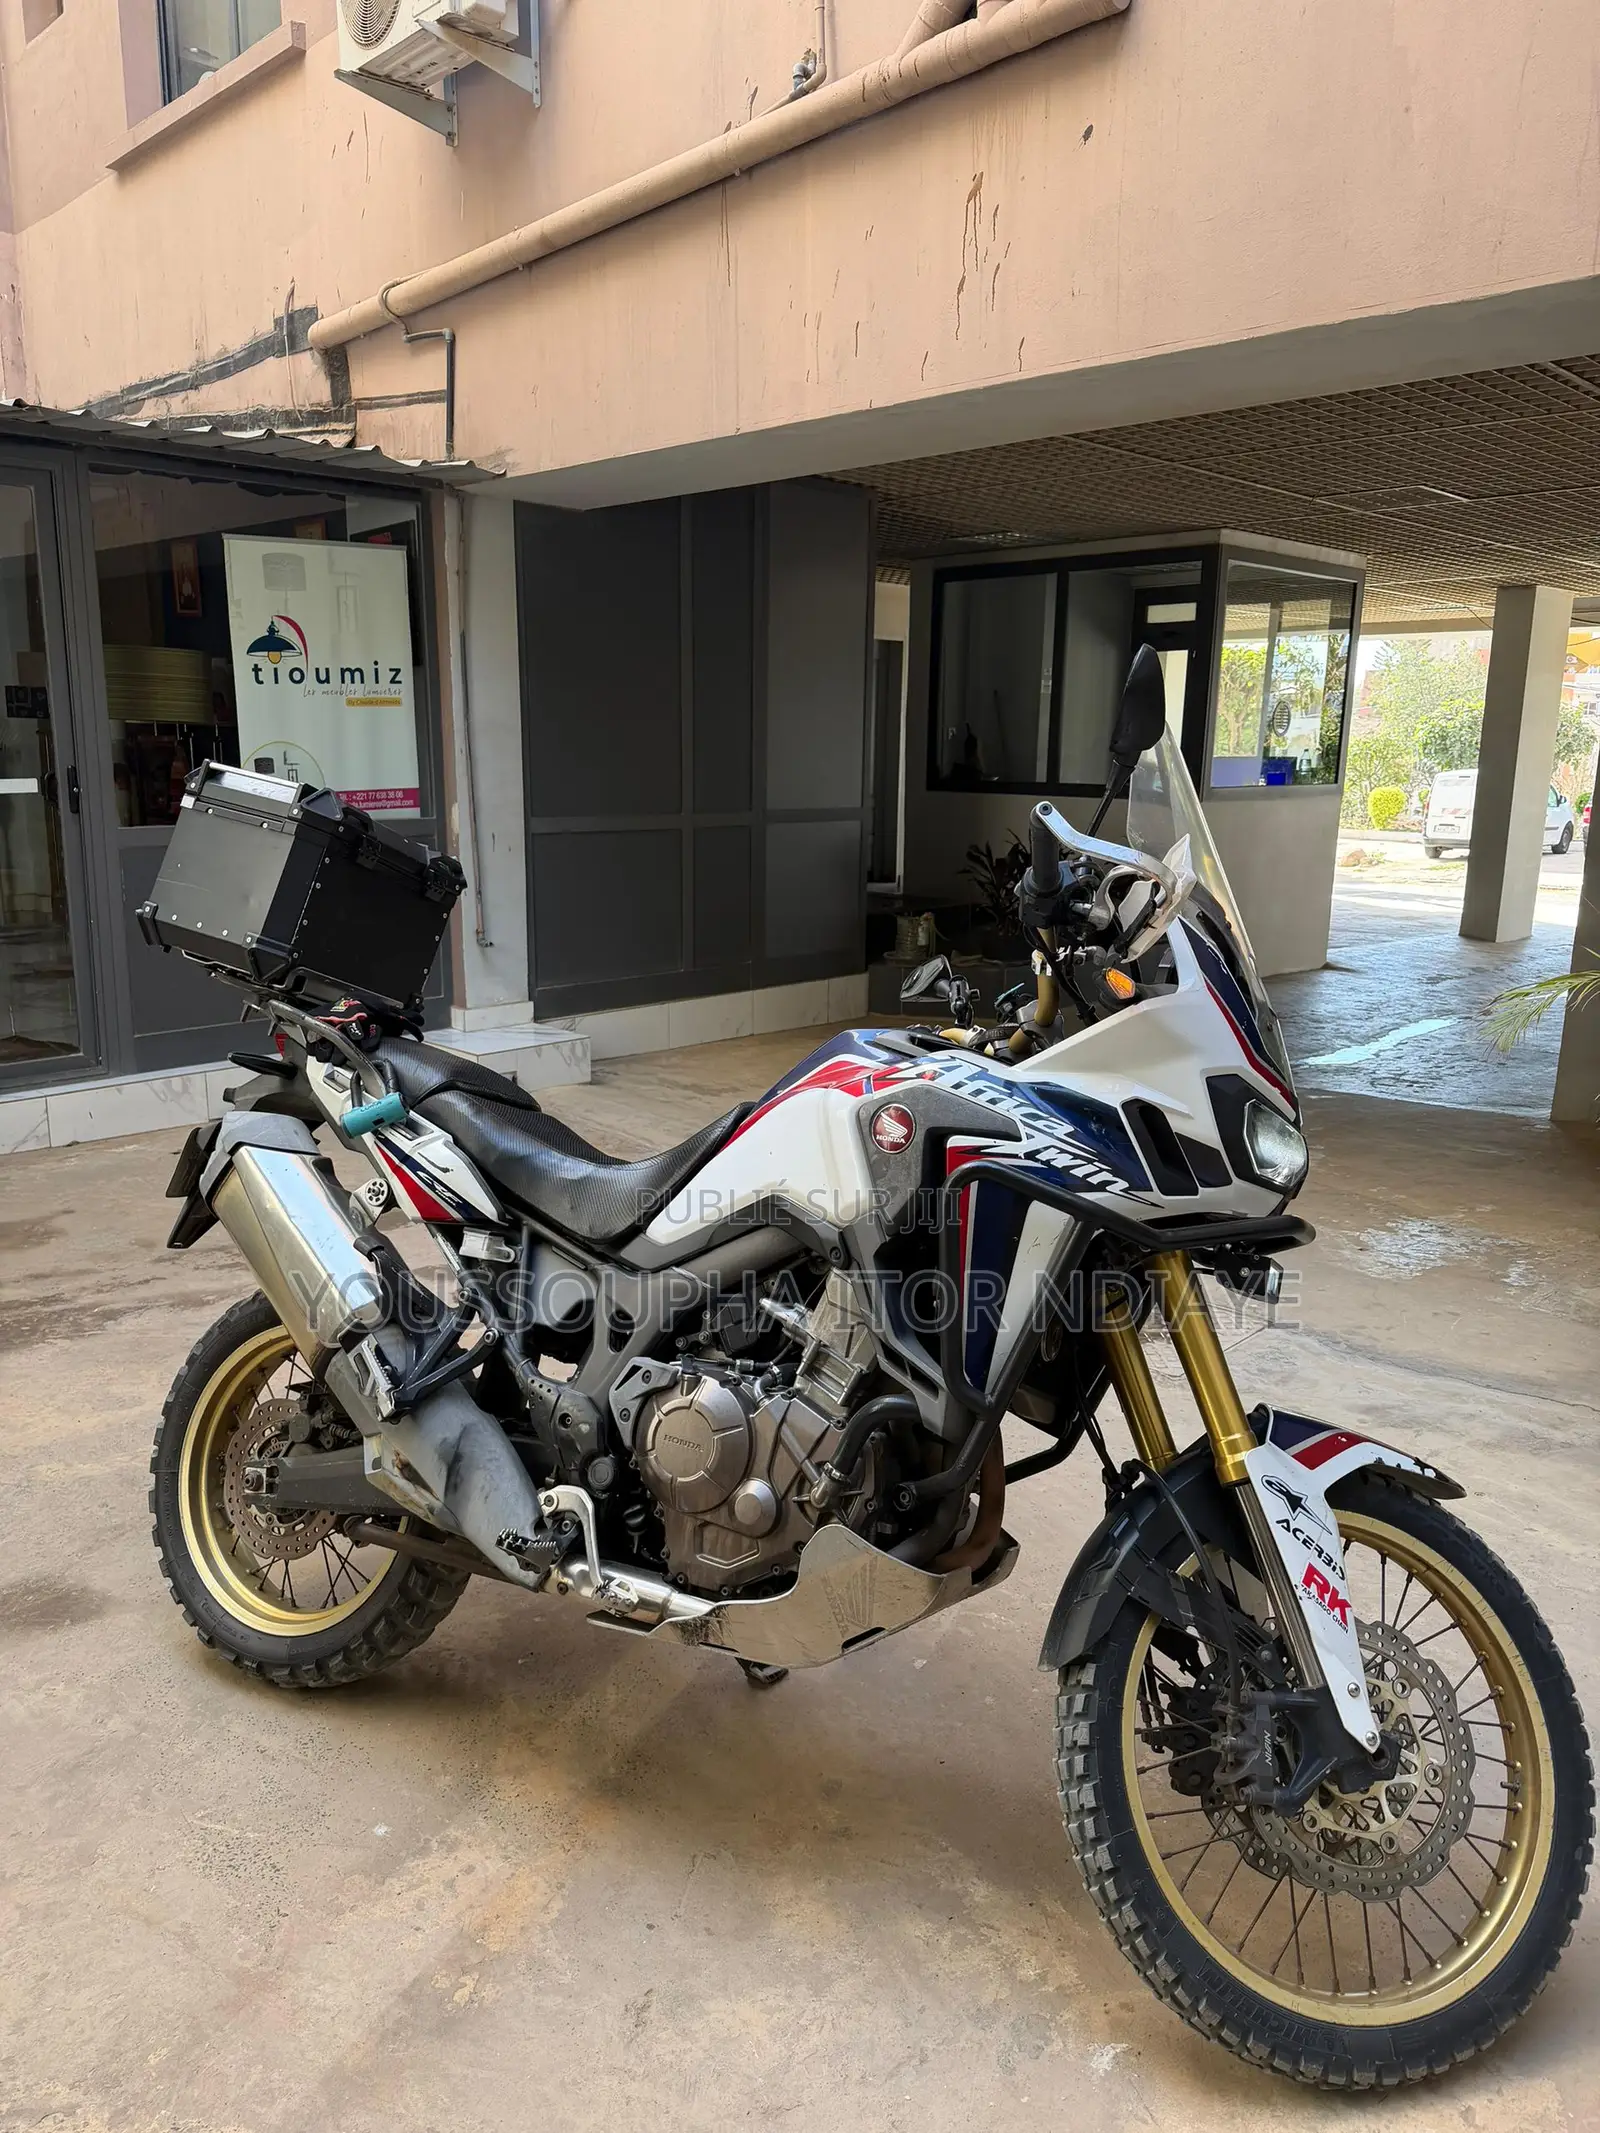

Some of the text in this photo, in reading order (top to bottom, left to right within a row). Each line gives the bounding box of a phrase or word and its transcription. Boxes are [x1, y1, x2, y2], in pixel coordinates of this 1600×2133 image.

[252, 660, 402, 685] tioumiz
[875, 1133, 906, 1144] HONDA
[664, 1434, 704, 1453] HONDA
[1300, 1561, 1352, 1626] RK
